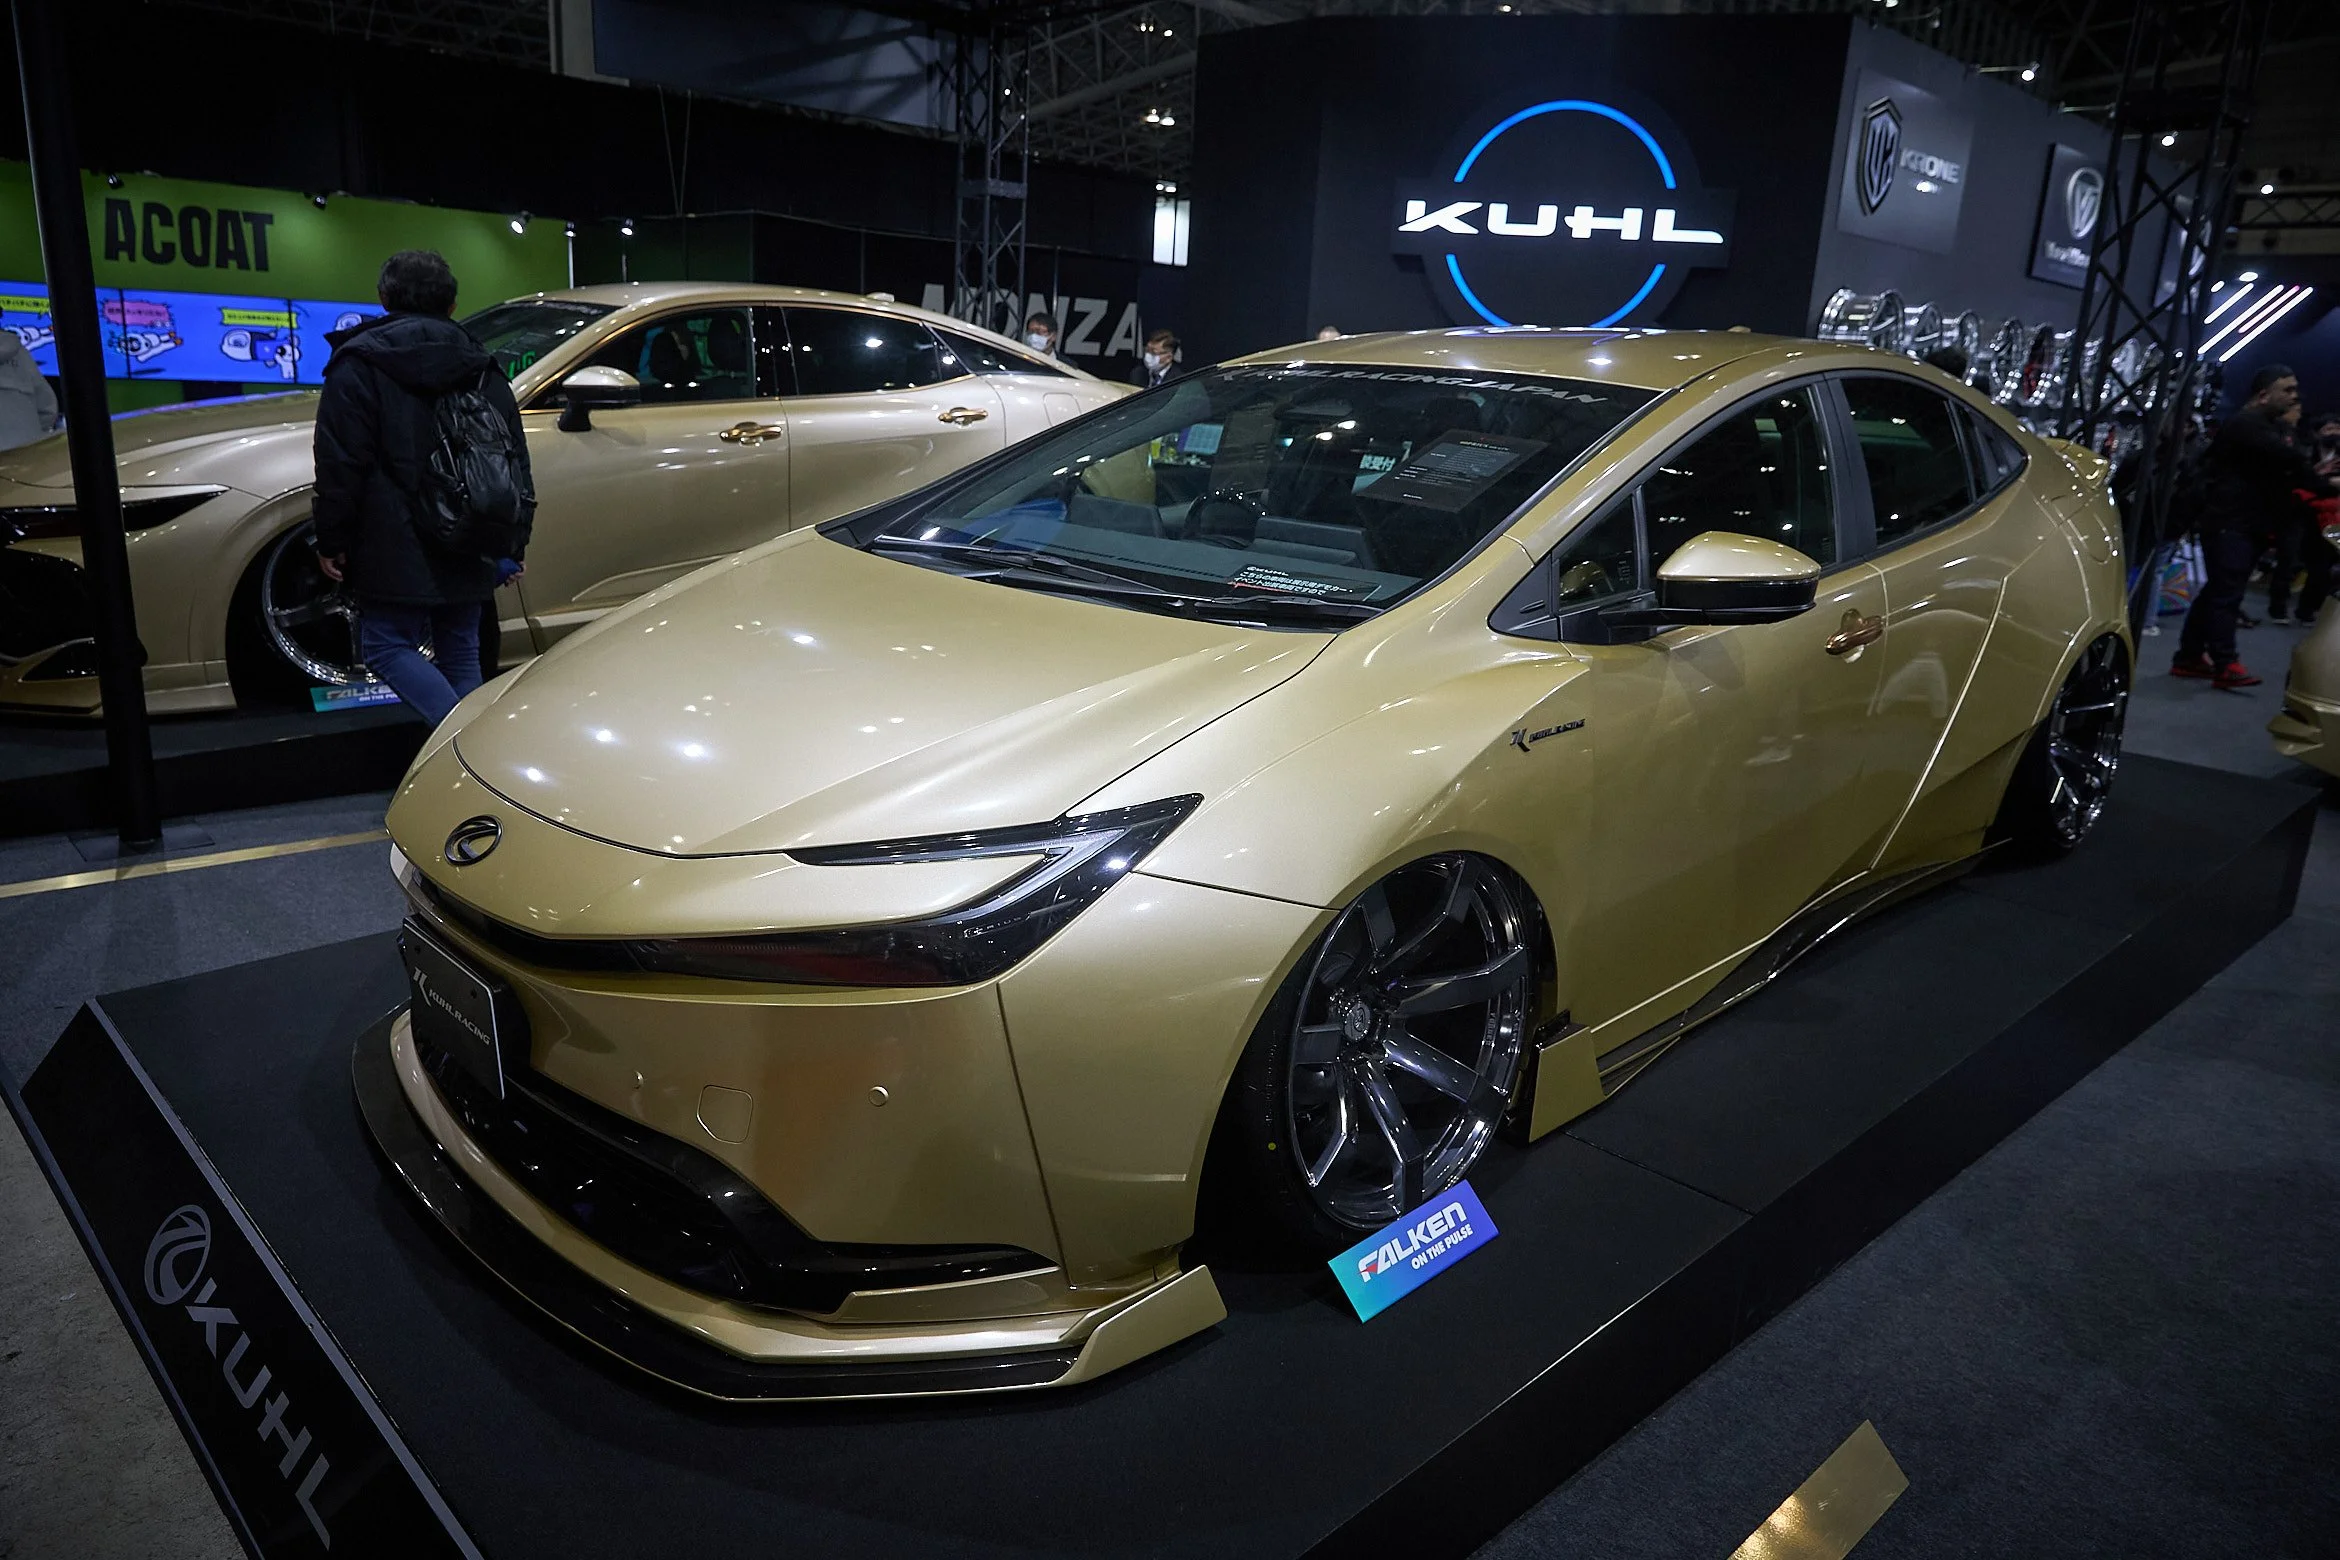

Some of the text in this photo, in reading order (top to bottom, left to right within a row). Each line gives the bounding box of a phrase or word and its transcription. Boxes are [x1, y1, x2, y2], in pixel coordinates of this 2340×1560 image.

[1398, 199, 1724, 244] KUHL
[1357, 1201, 1468, 1283] FALKEN
[1411, 1223, 1474, 1270] ON THE PULSE
[185, 1276, 331, 1551] KUHL
